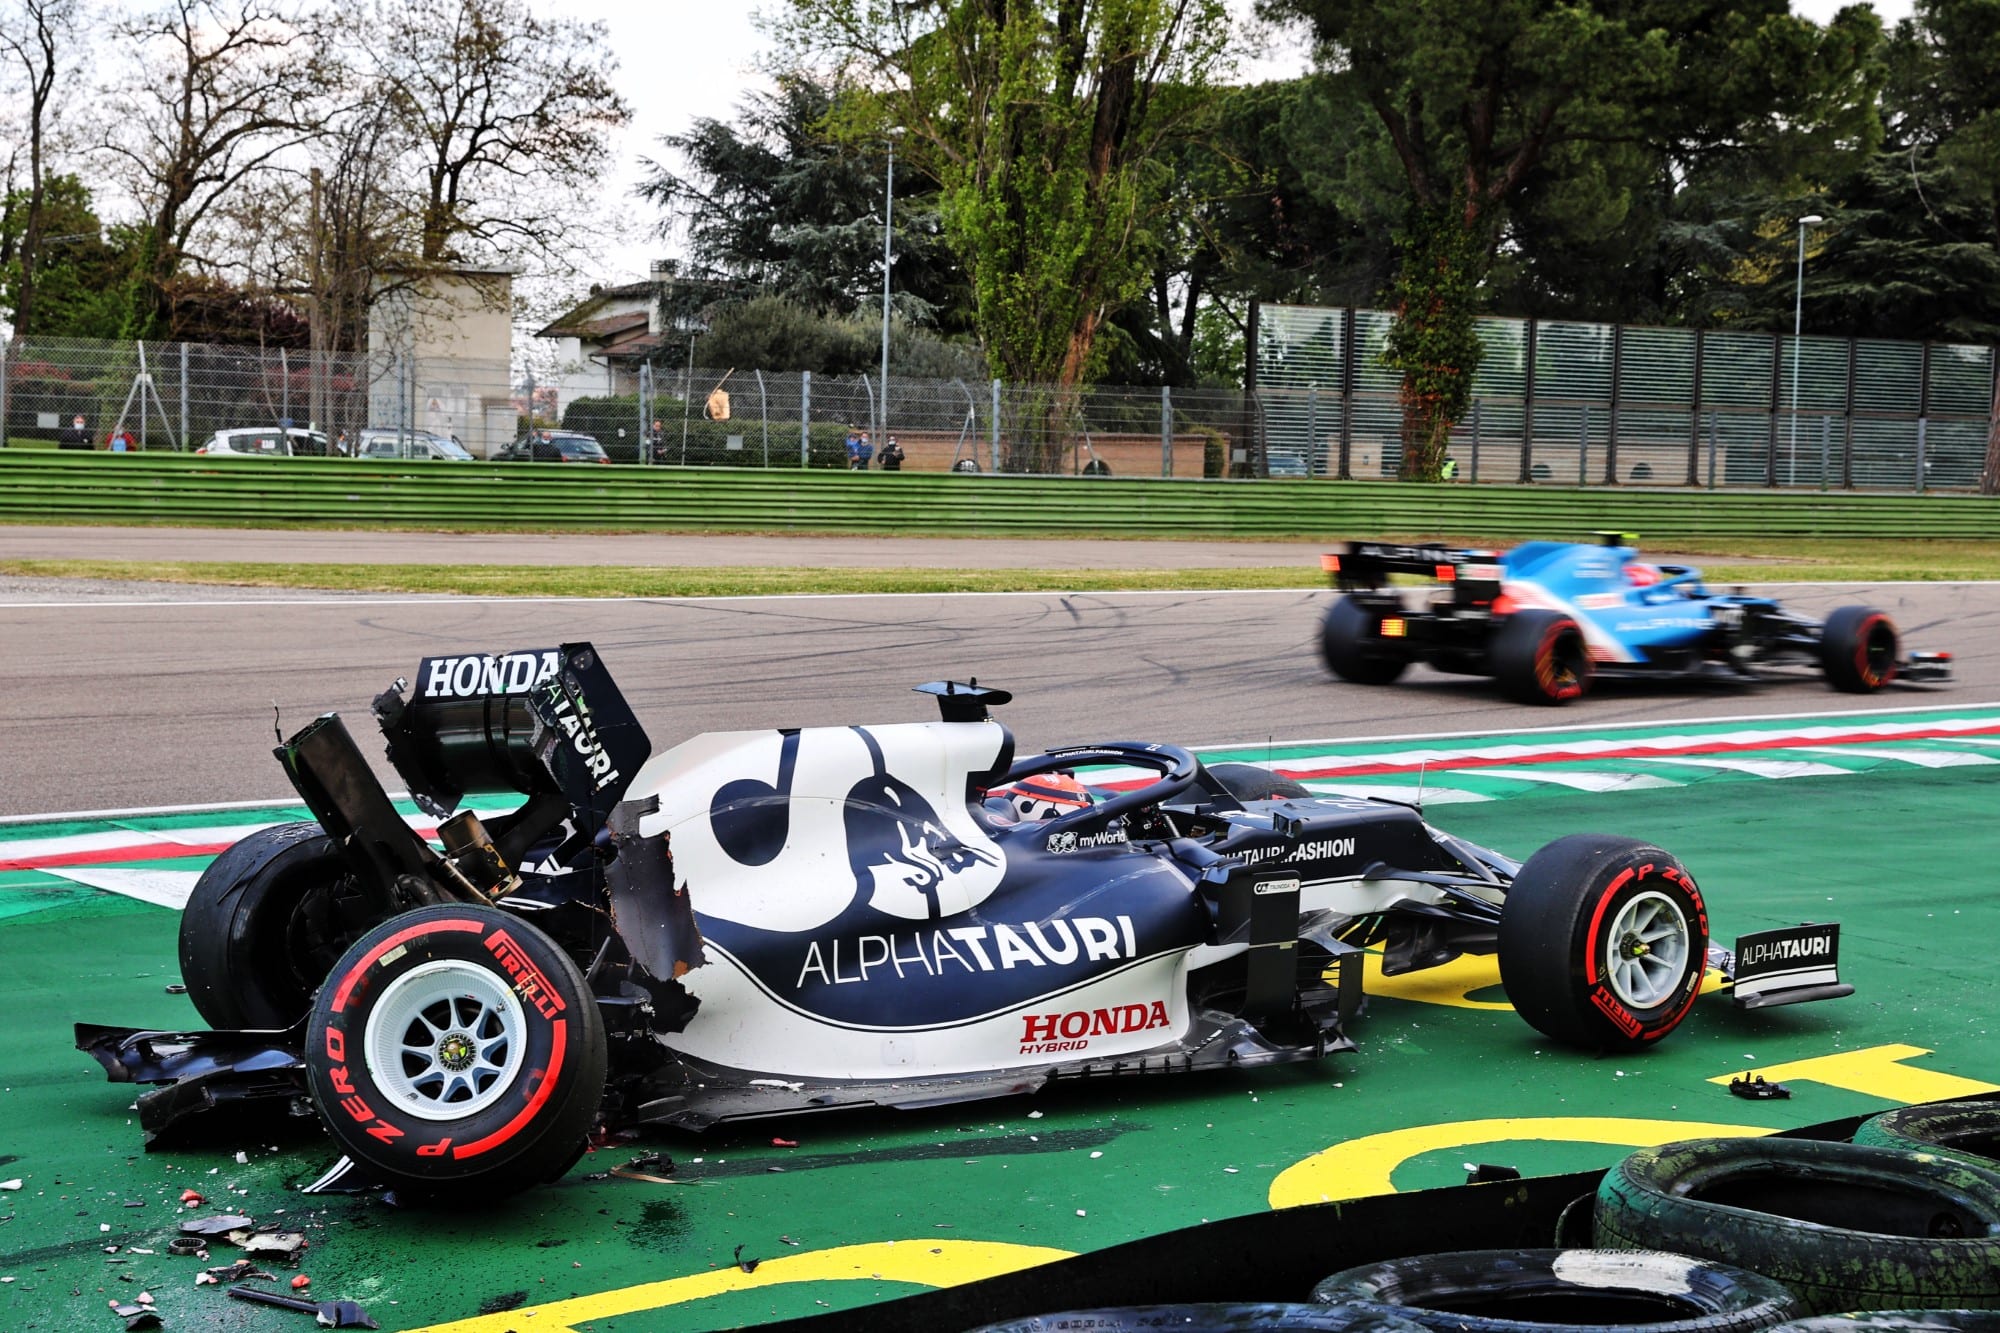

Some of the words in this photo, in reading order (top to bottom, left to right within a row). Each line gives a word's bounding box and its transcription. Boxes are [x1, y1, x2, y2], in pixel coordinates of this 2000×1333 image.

[425, 652, 559, 697] HONDA
[1080, 830, 1127, 848] myWorld
[1637, 863, 1654, 881] P
[1662, 866, 1708, 936] ZERO
[797, 914, 1137, 988] ALPHATAURI
[1741, 934, 1831, 967] ALPHATAURI
[484, 928, 567, 1020] PIRELLI
[1020, 1000, 1170, 1044] HONDA
[1590, 985, 1644, 1039] PIRELLI
[1019, 1039, 1089, 1055] HYBRID
[325, 1026, 405, 1144] ZERO
[416, 1138, 453, 1156] P
